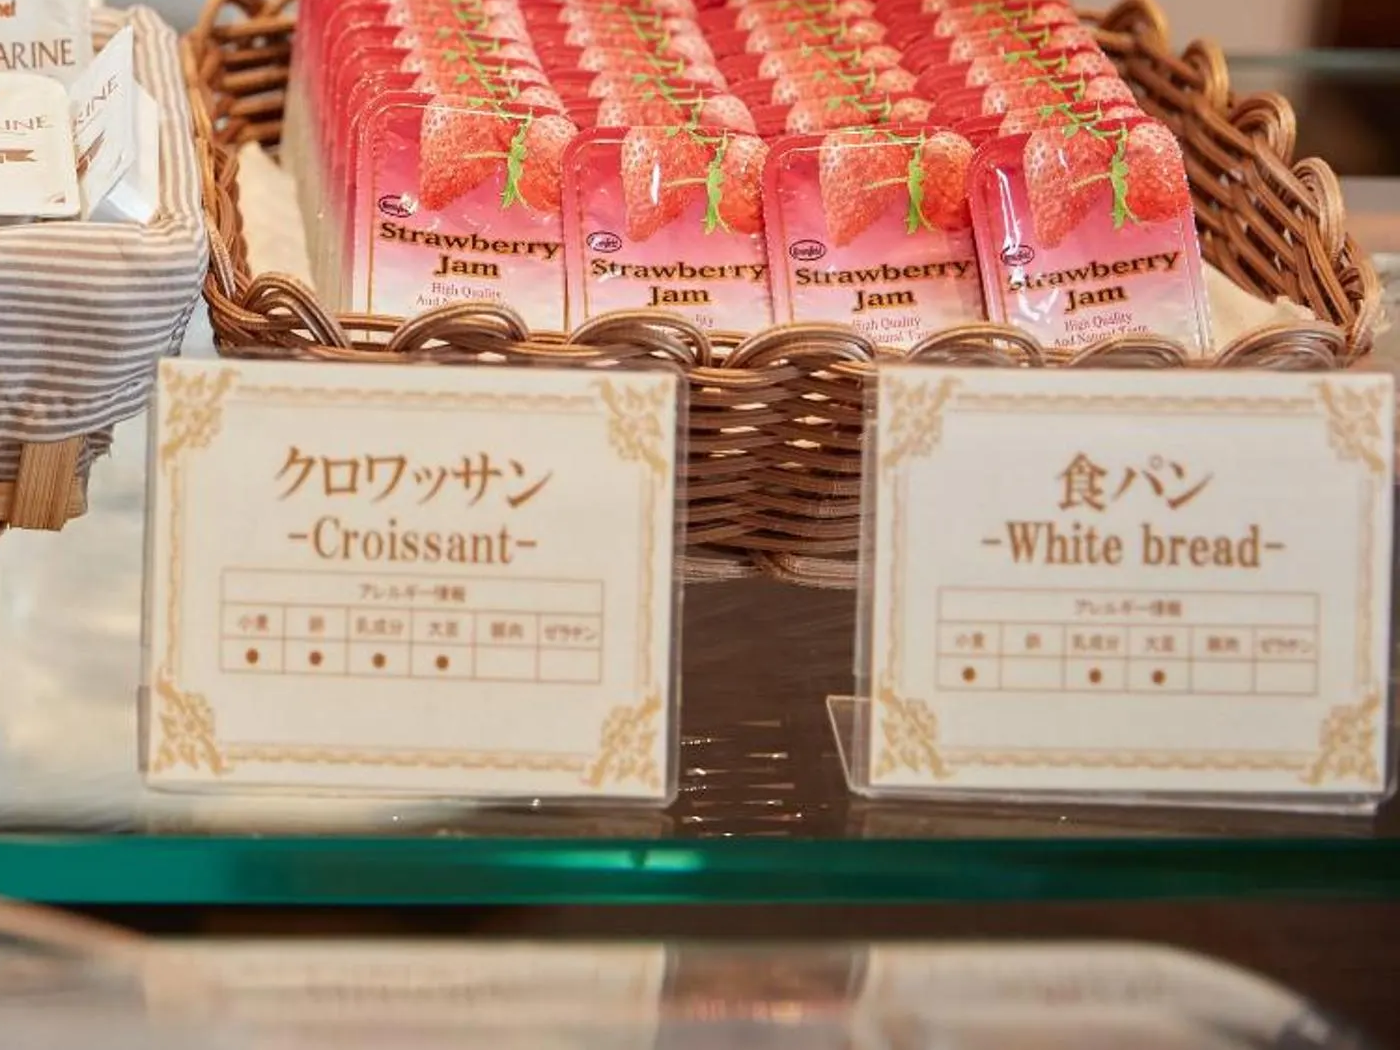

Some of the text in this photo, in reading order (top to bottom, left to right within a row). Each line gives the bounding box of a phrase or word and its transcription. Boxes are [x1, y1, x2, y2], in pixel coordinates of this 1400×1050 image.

[380, 222, 564, 260] Strawberry
[434, 253, 499, 278] Jam
[591, 257, 769, 281] Strawberry
[795, 259, 973, 286] Strawberry
[432, 282, 458, 297] High
[648, 286, 710, 307] Jam
[853, 290, 916, 313] Jam
[1064, 285, 1126, 314] Jam
[880, 316, 921, 332] Quality
[275, 445, 555, 509] クロワッサン
[1056, 450, 1214, 512] 食パン
[359, 582, 467, 603] アレルギー情報
[1074, 598, 1183, 618] アレルギー情報
